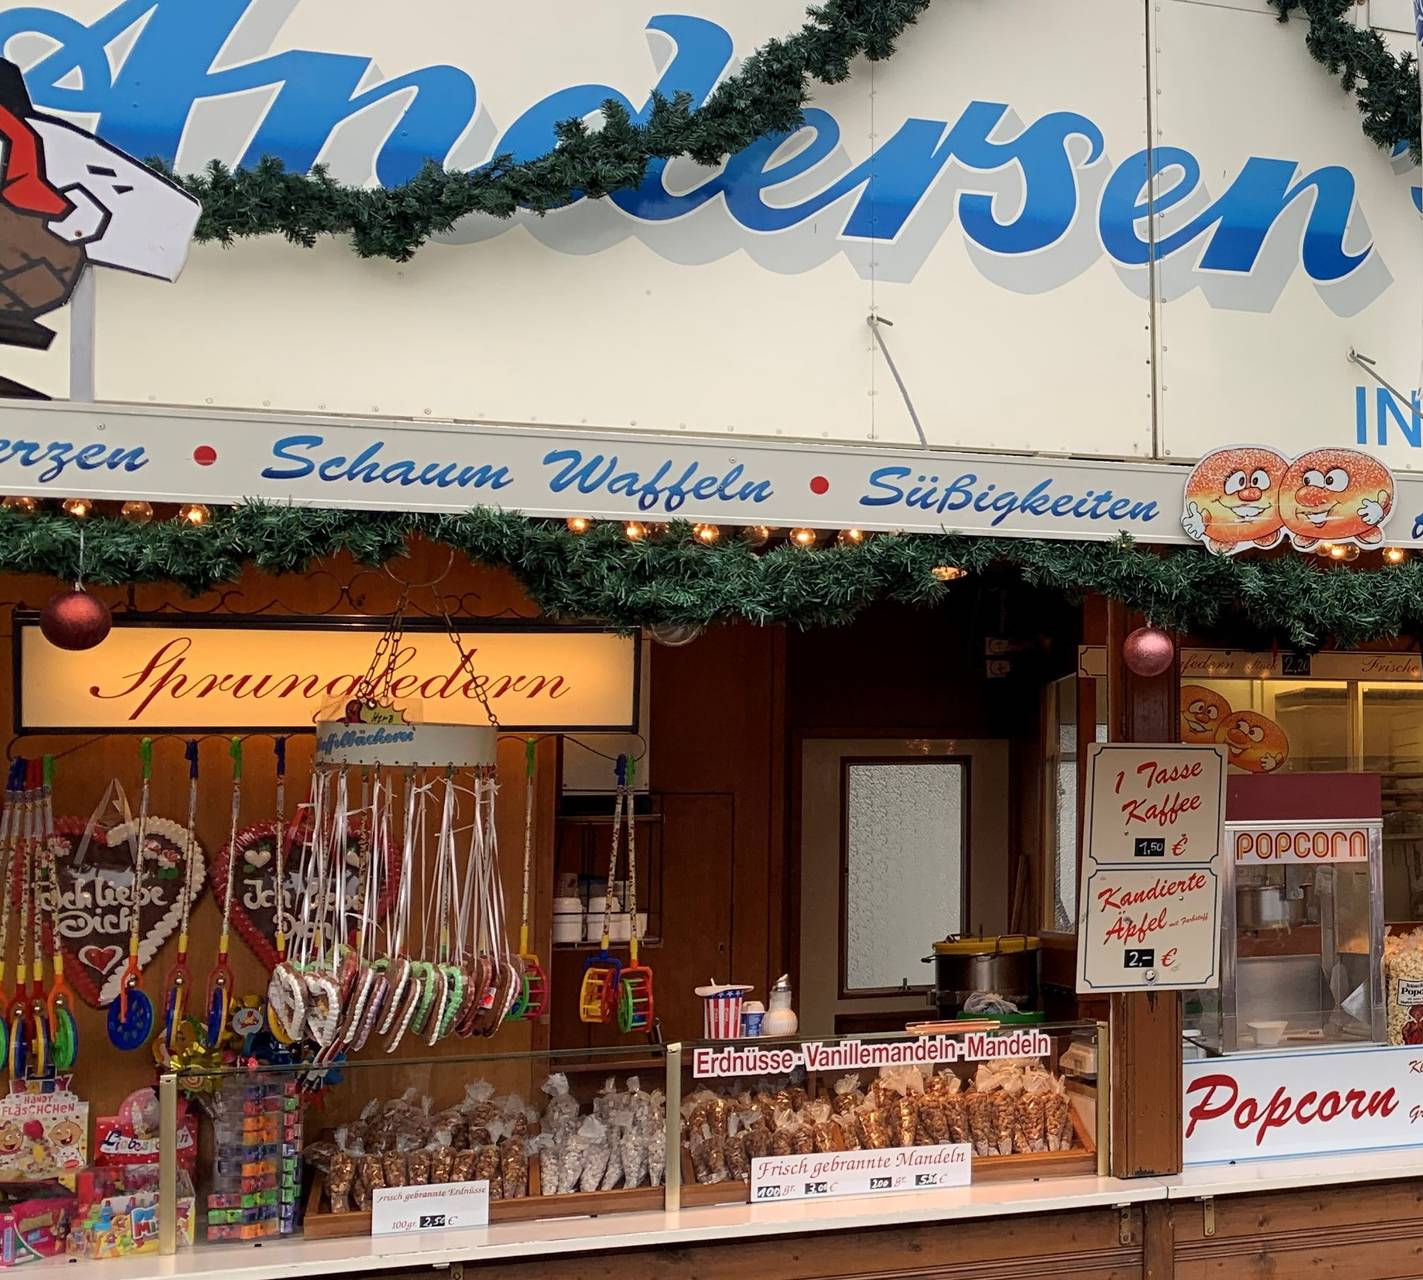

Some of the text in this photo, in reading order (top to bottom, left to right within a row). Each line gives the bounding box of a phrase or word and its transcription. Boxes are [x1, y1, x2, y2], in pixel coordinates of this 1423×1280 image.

[261, 435, 514, 490] Schaum
[542, 449, 773, 511] Waffeln
[859, 466, 1160, 526] Süßigkeiten
[1362, 655, 1420, 674] Frische
[1115, 761, 1203, 794] 1 Tasse
[1121, 792, 1202, 827] Kaffee
[1171, 836, 1187, 857] €
[94, 876, 168, 907] liebe
[1098, 874, 1207, 912] Kandierte
[58, 907, 134, 938] Dich
[1104, 908, 1167, 945] Äpfel
[1161, 948, 1178, 967] €
[697, 1031, 1049, 1075] Erdnüsse Vanillemandeln Mandeln
[1185, 1074, 1399, 1146] Popcorn
[757, 1146, 966, 1179] Frisch gebrannte Mandeln
[404, 1190, 446, 1202] gebrannte
[448, 1186, 486, 1197] Erdnüsse
